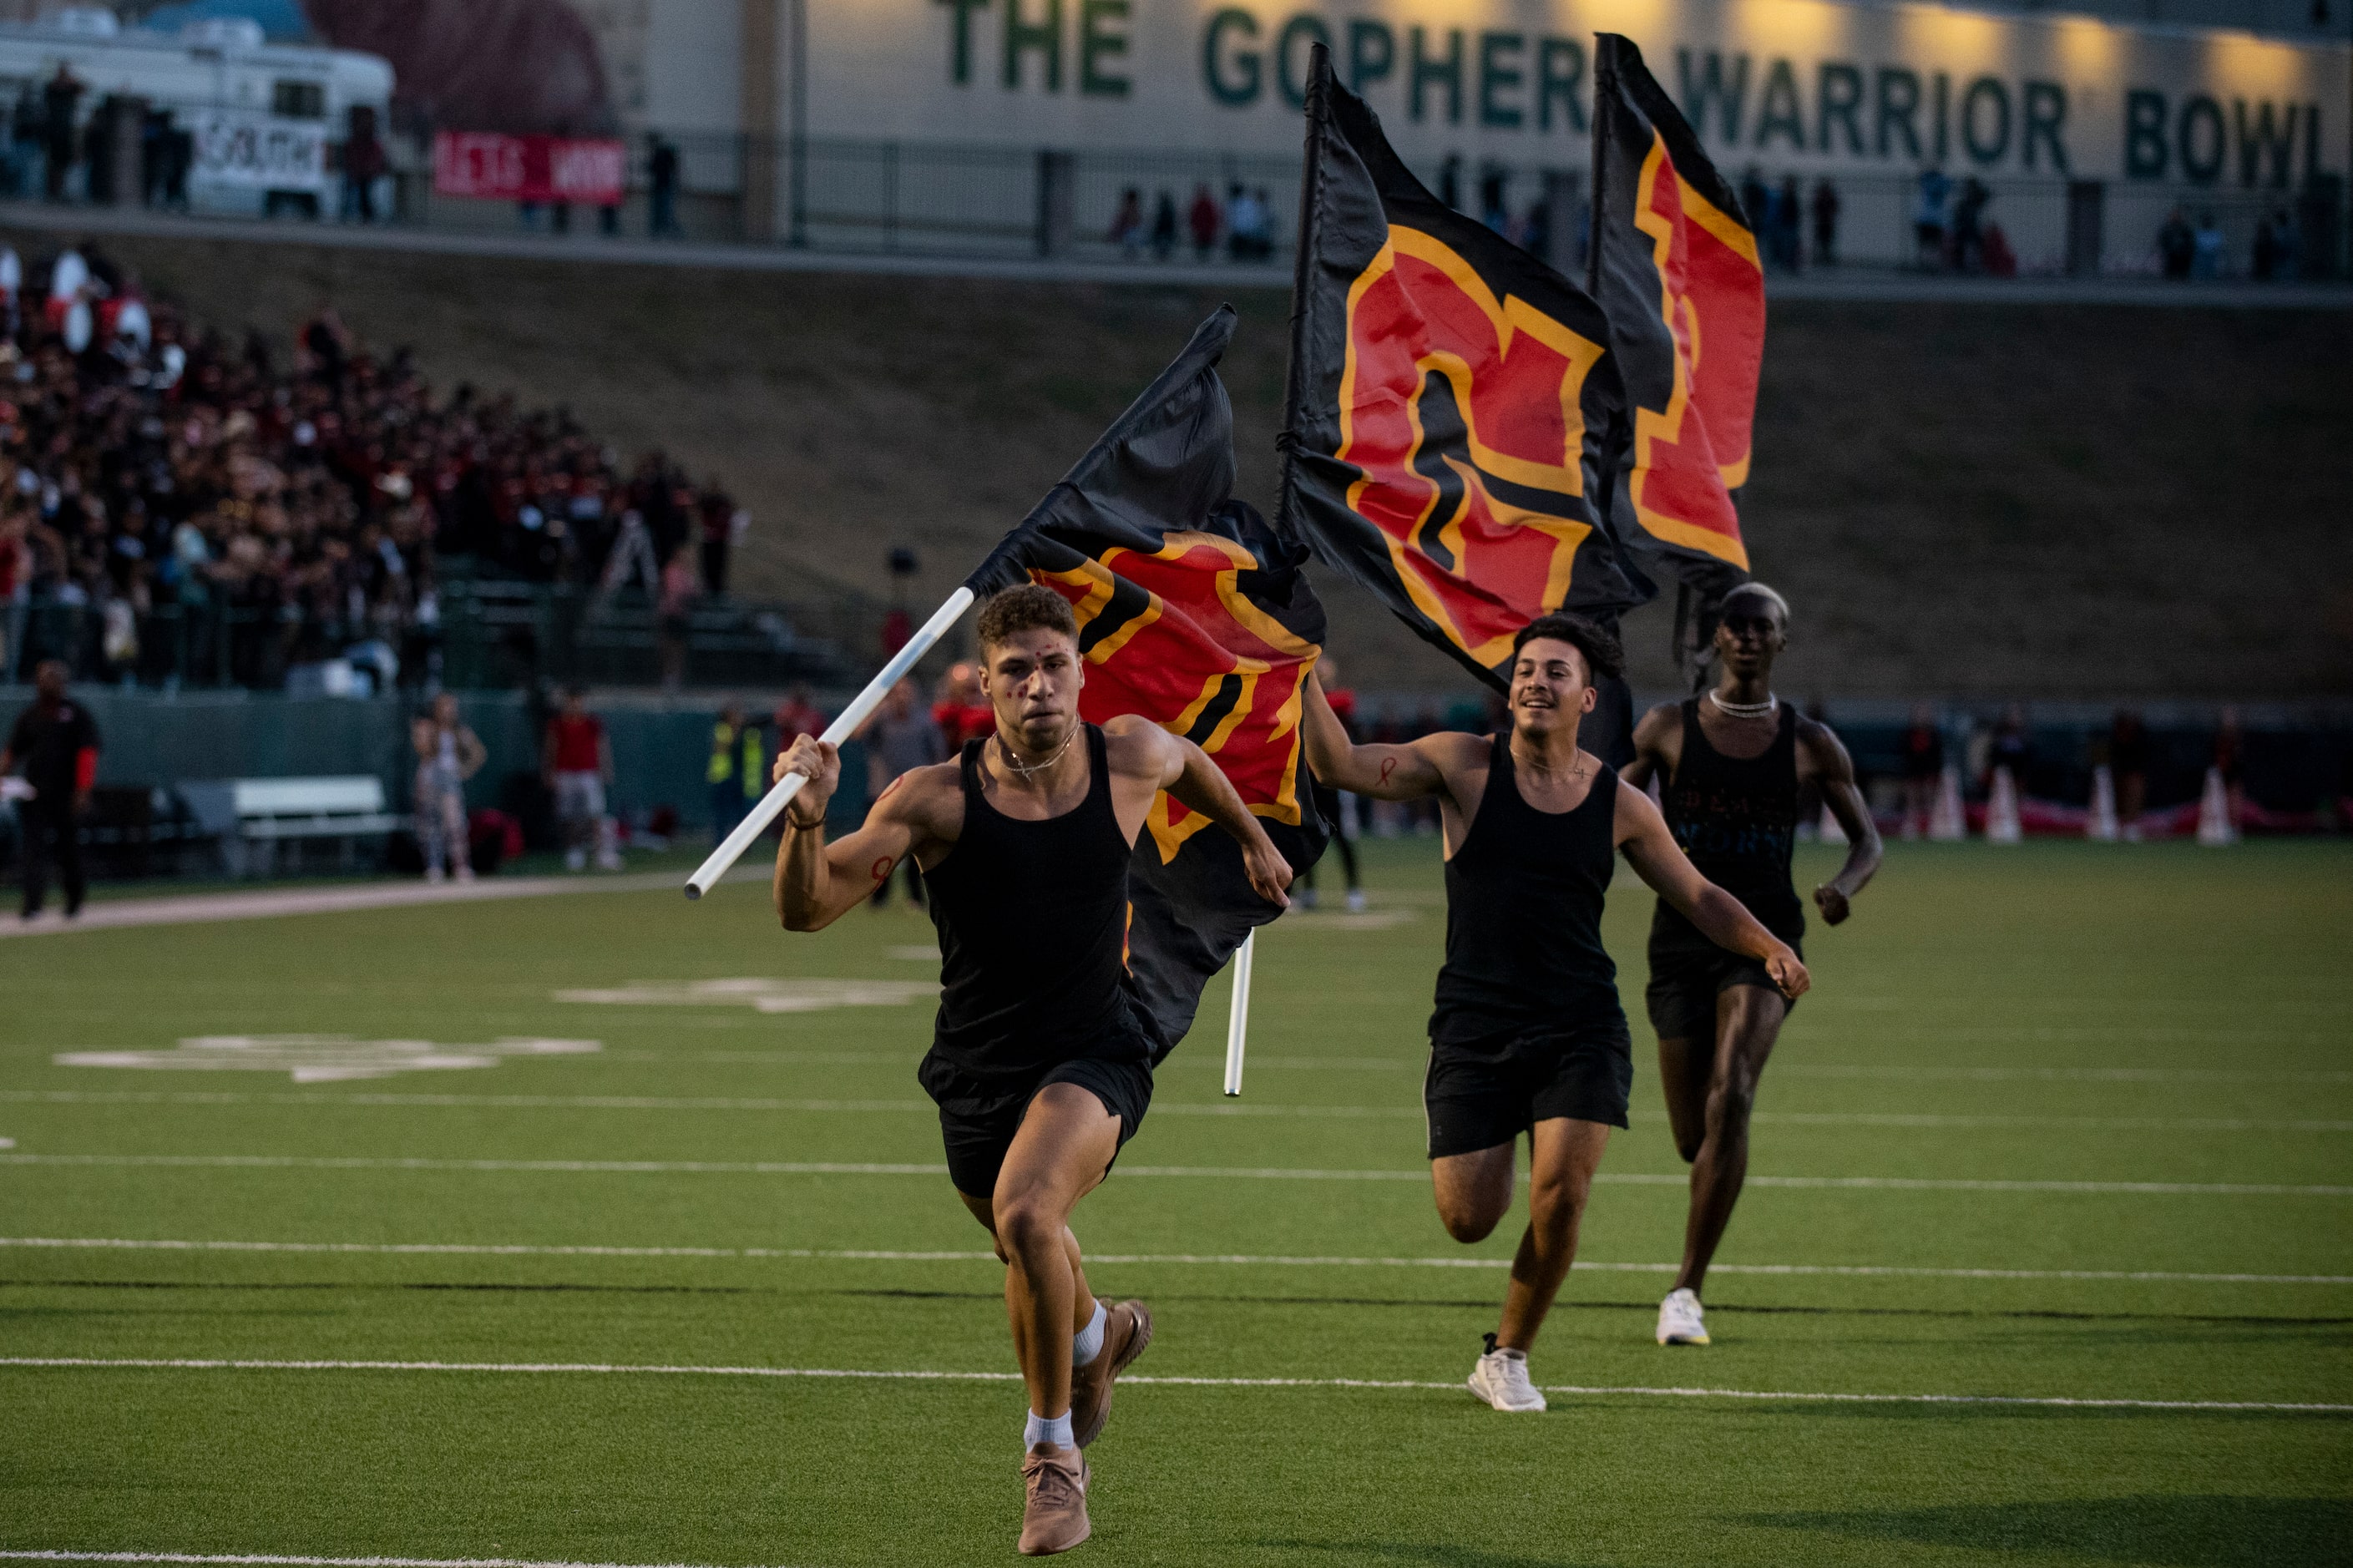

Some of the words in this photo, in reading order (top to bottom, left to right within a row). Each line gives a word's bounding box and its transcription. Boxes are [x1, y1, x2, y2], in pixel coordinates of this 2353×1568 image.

[935, 0, 1131, 94] THE
[1206, 8, 1586, 132] GOPHER
[1672, 47, 2067, 172] WARRIOR
[2128, 90, 2343, 191] BOWL
